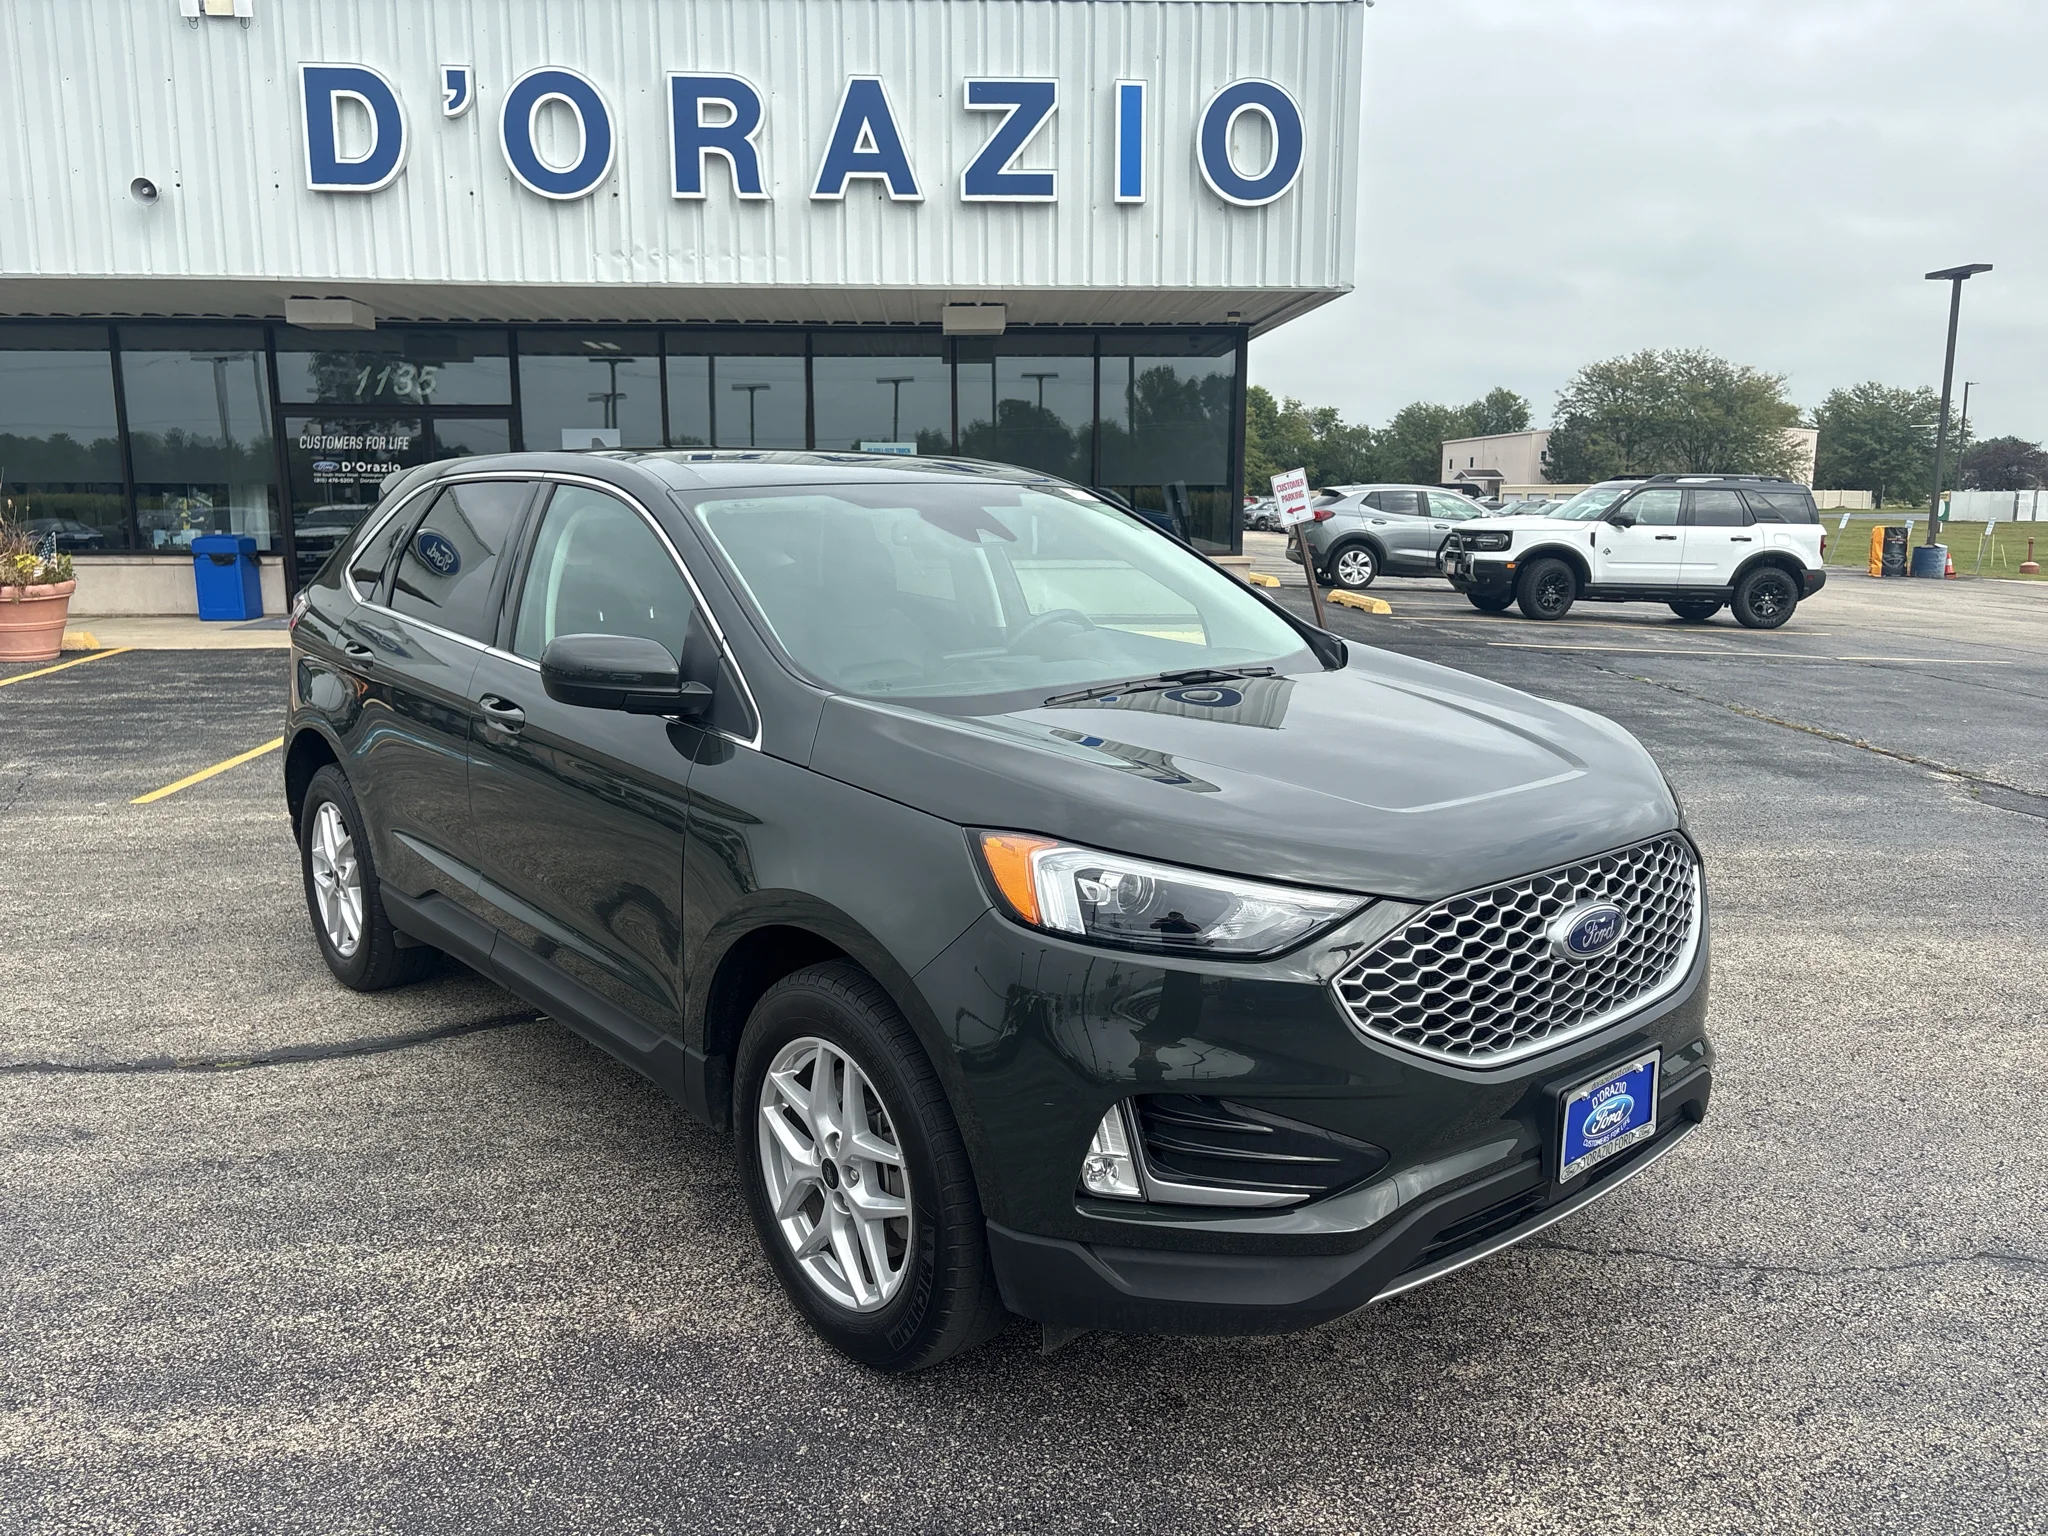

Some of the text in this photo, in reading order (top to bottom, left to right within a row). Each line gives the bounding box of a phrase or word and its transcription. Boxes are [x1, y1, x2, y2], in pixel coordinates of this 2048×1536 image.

[298, 62, 1307, 207] D'ORAZIO
[355, 365, 438, 396] 1135
[299, 435, 410, 450] CUSTOMERS FOR LIFE
[341, 461, 401, 473] D'Orazio
[1275, 478, 1305, 493] CUSTOMER
[1281, 490, 1305, 503] PARKING
[1582, 916, 1615, 948] Ford
[1592, 1081, 1627, 1109] D'ORAZIO
[1582, 1117, 1631, 1148] CUSTOMERS FOR LIFE
[1591, 1101, 1625, 1134] Ford
[1581, 1131, 1634, 1170] D'ORAZIO FORD
[890, 1258, 933, 1348] MICHELIN
